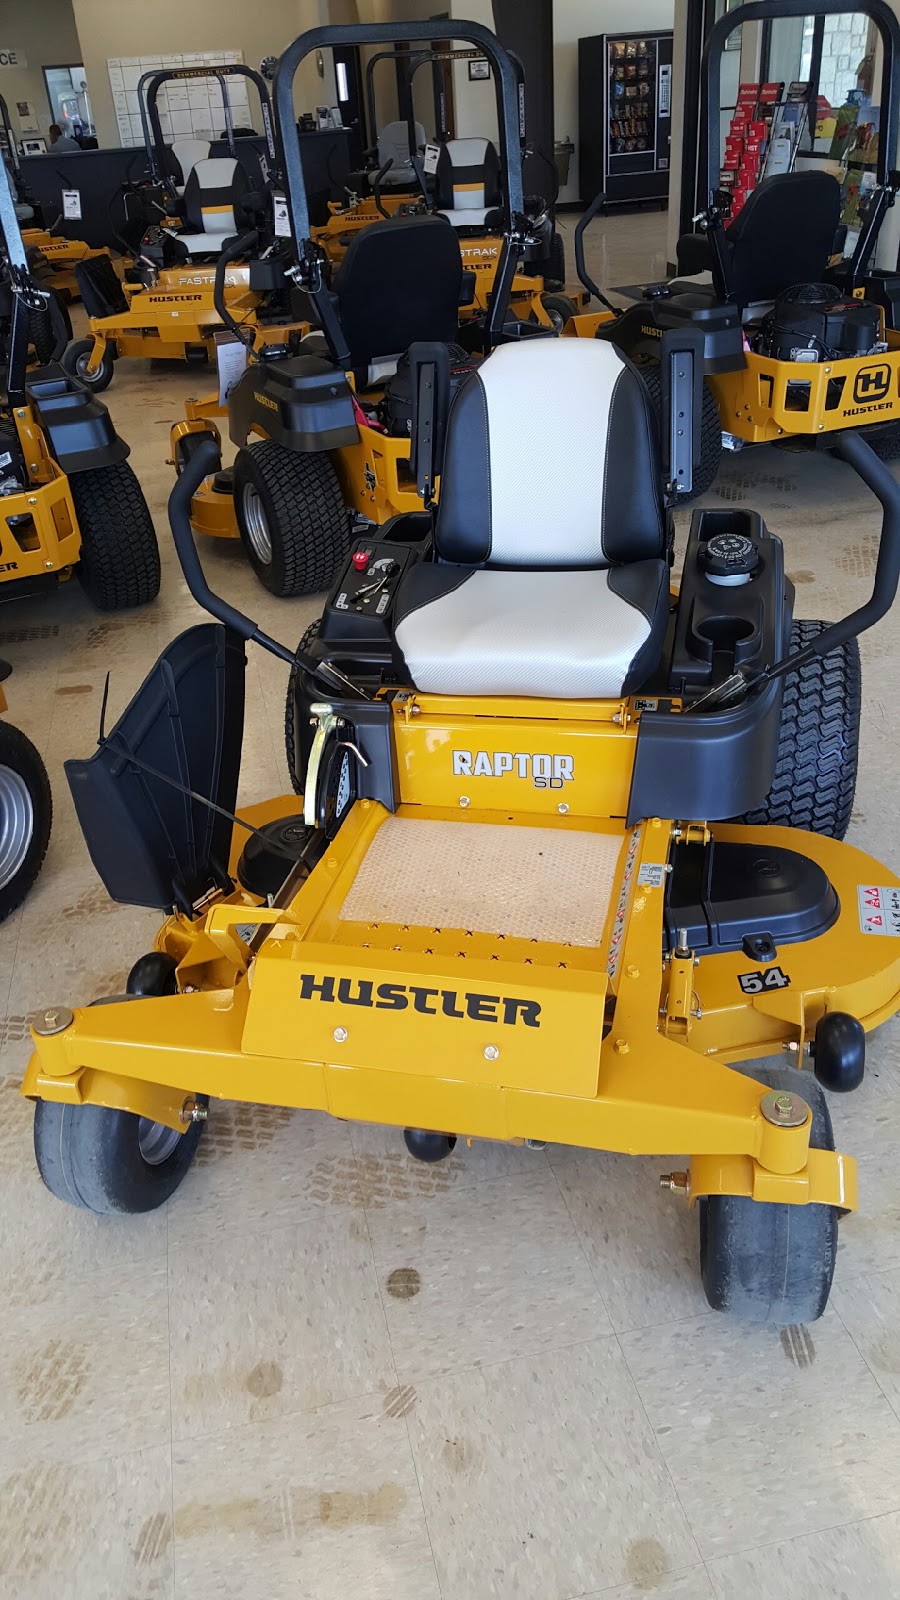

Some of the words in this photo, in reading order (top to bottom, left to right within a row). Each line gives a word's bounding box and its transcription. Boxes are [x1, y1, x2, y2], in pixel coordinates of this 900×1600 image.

[0, 53, 18, 65] CE
[38, 244, 69, 252] USTLER
[460, 248, 498, 257] STRAK
[254, 391, 278, 411] HUSTLER
[843, 402, 893, 417] HUSTLER
[452, 750, 574, 780] RAPTOR
[534, 777, 563, 788] SD
[740, 969, 788, 993] 54
[299, 974, 541, 1028] HUSTLER
